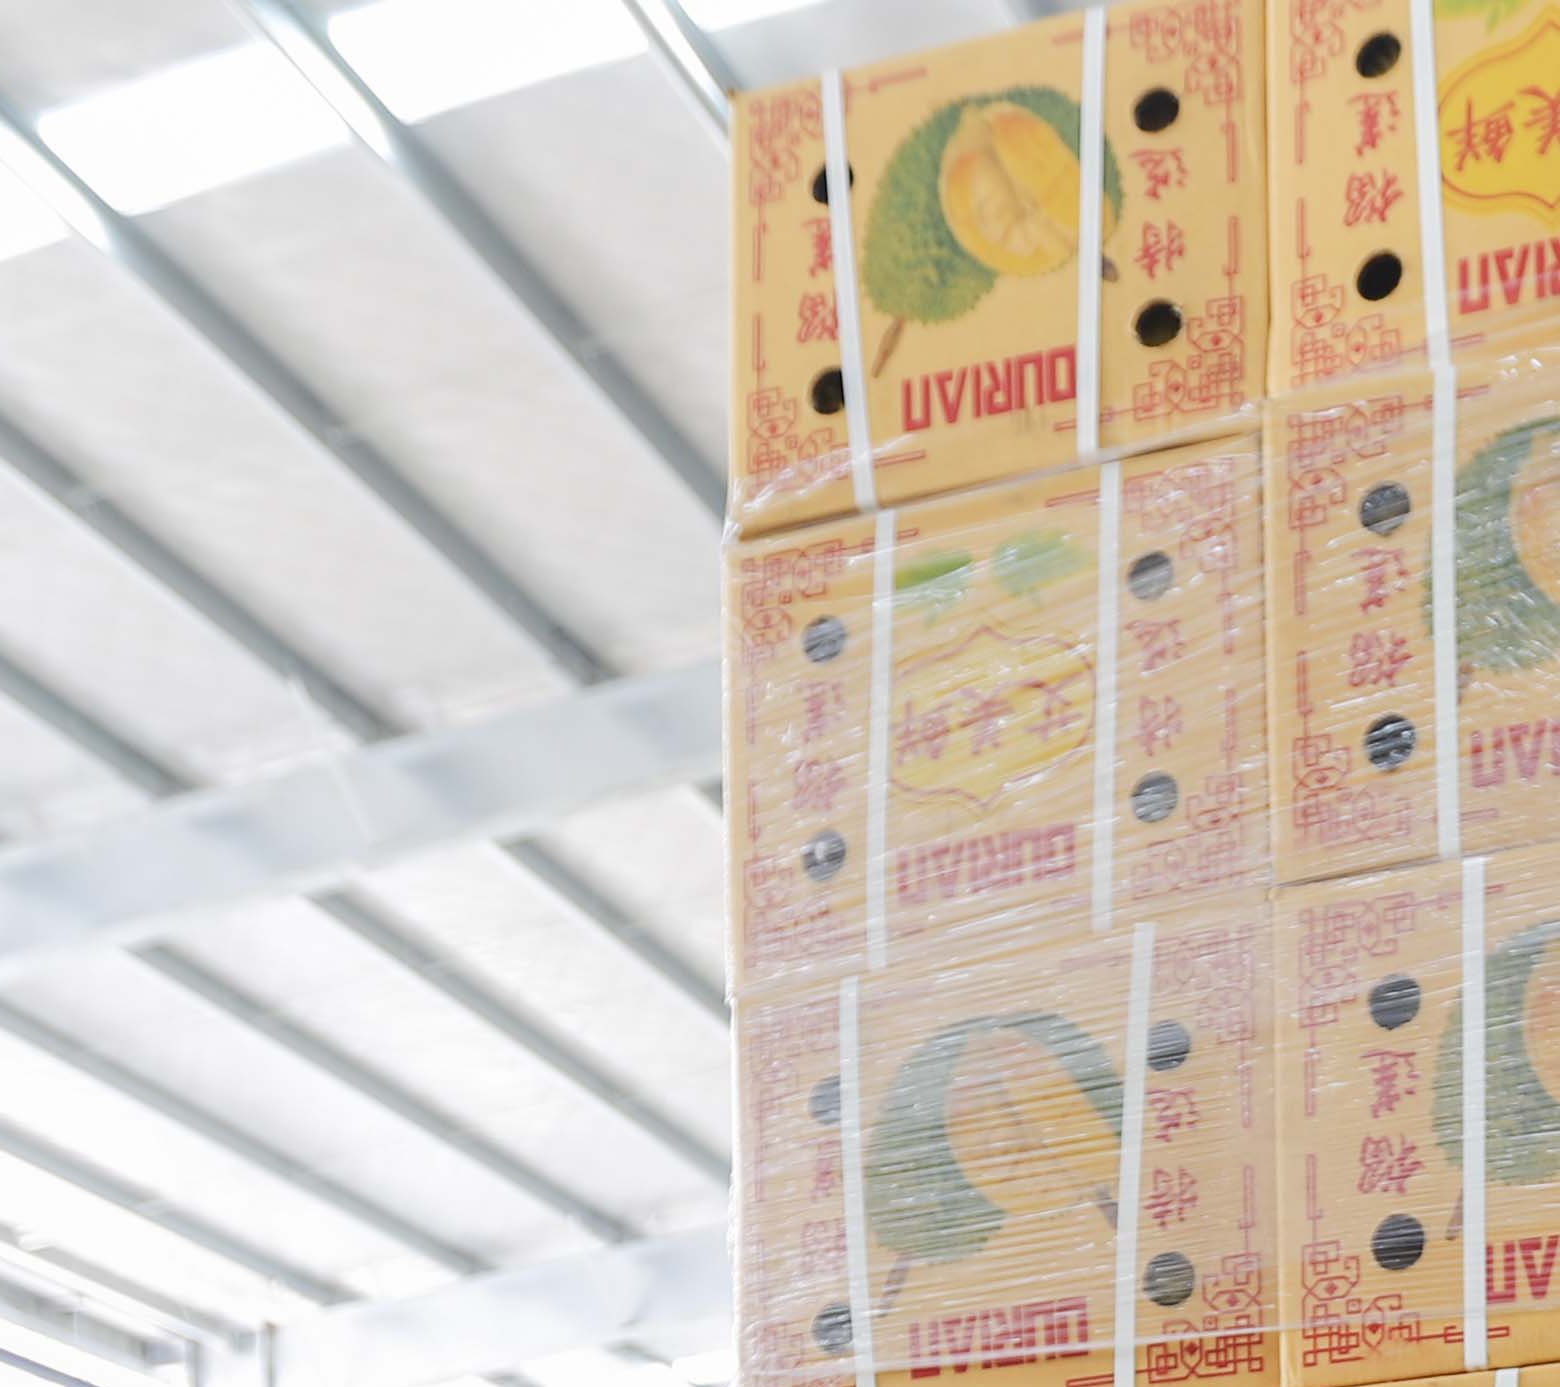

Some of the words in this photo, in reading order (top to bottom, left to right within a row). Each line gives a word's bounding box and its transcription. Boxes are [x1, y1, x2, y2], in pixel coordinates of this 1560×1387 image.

[1130, 148, 1188, 279] 特选
[1345, 92, 1404, 226] 榴莲
[902, 345, 1077, 432] DURIAN
[1347, 548, 1414, 689] 榴莲
[894, 824, 1076, 904] DURIAN
[1144, 1088, 1201, 1230] 特选
[1359, 1049, 1426, 1194] 榴莲
[909, 1297, 1088, 1380] DURIAN
